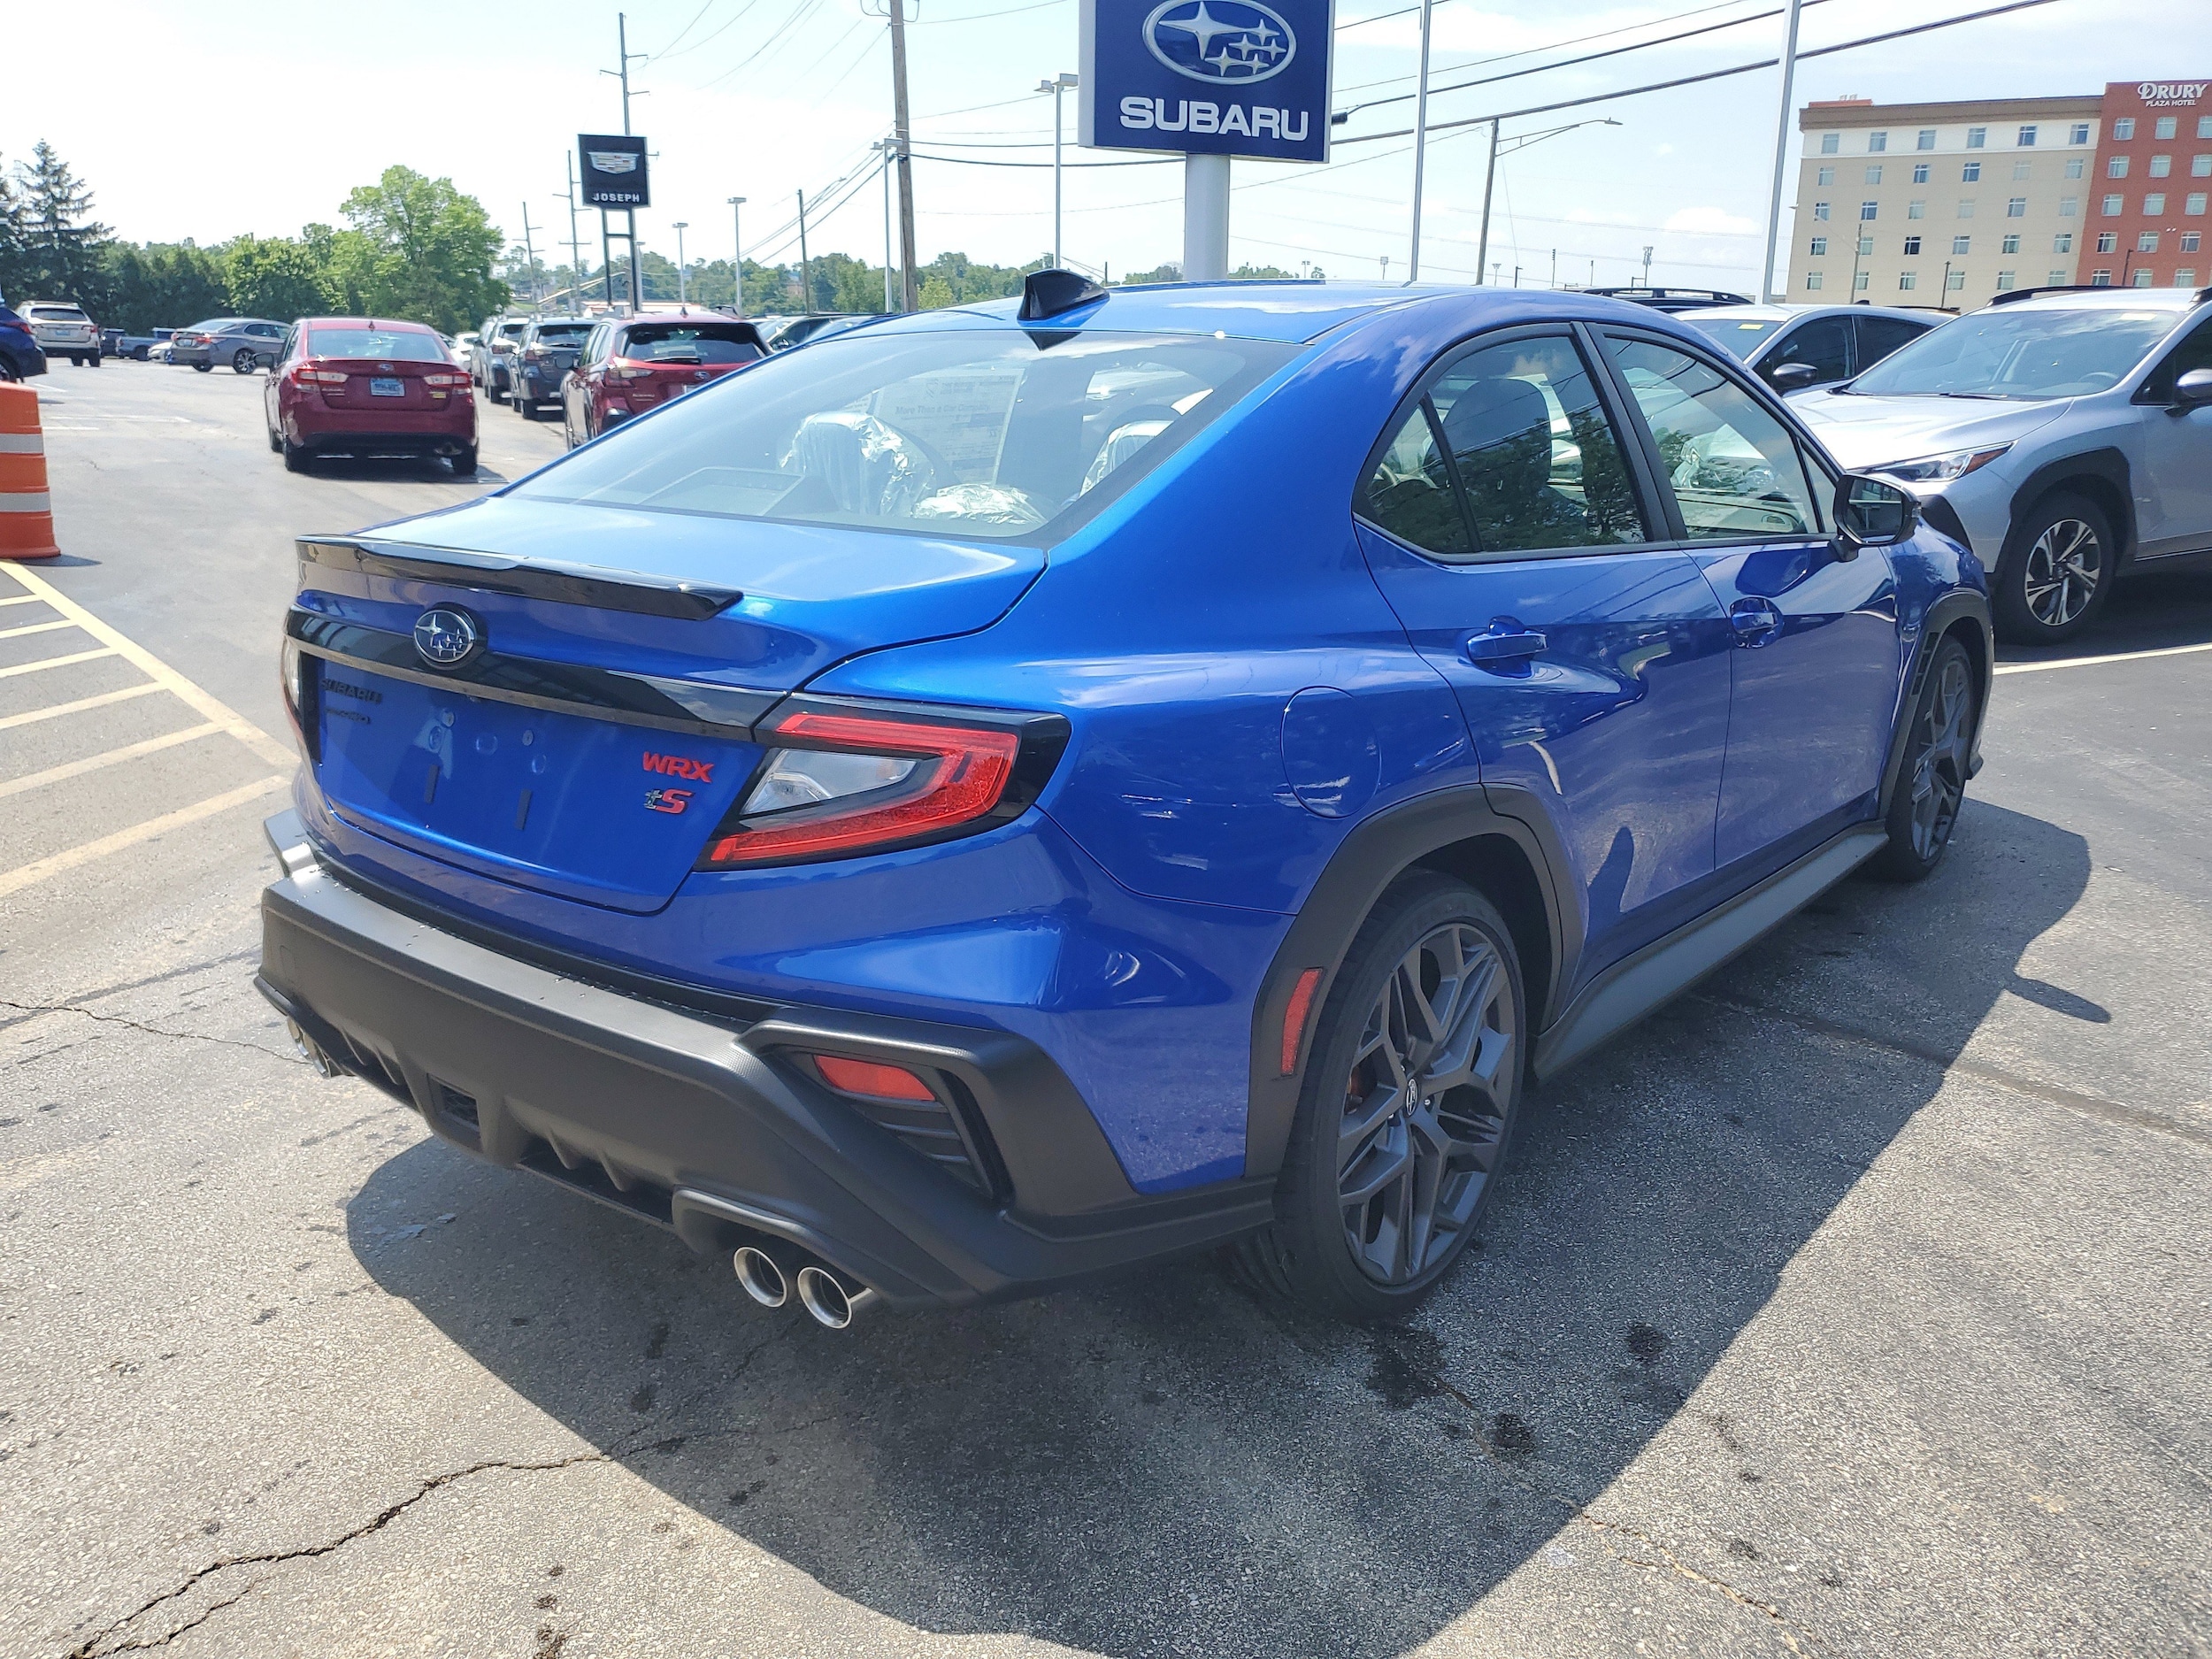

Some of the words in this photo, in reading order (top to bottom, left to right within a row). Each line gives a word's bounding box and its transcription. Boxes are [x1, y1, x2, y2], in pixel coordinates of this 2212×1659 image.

[2137, 82, 2208, 99] DRURY
[1120, 96, 1309, 141] SUBARU
[592, 192, 640, 203] JOSEPH
[321, 678, 382, 704] SUBARU
[642, 751, 714, 783] WRX
